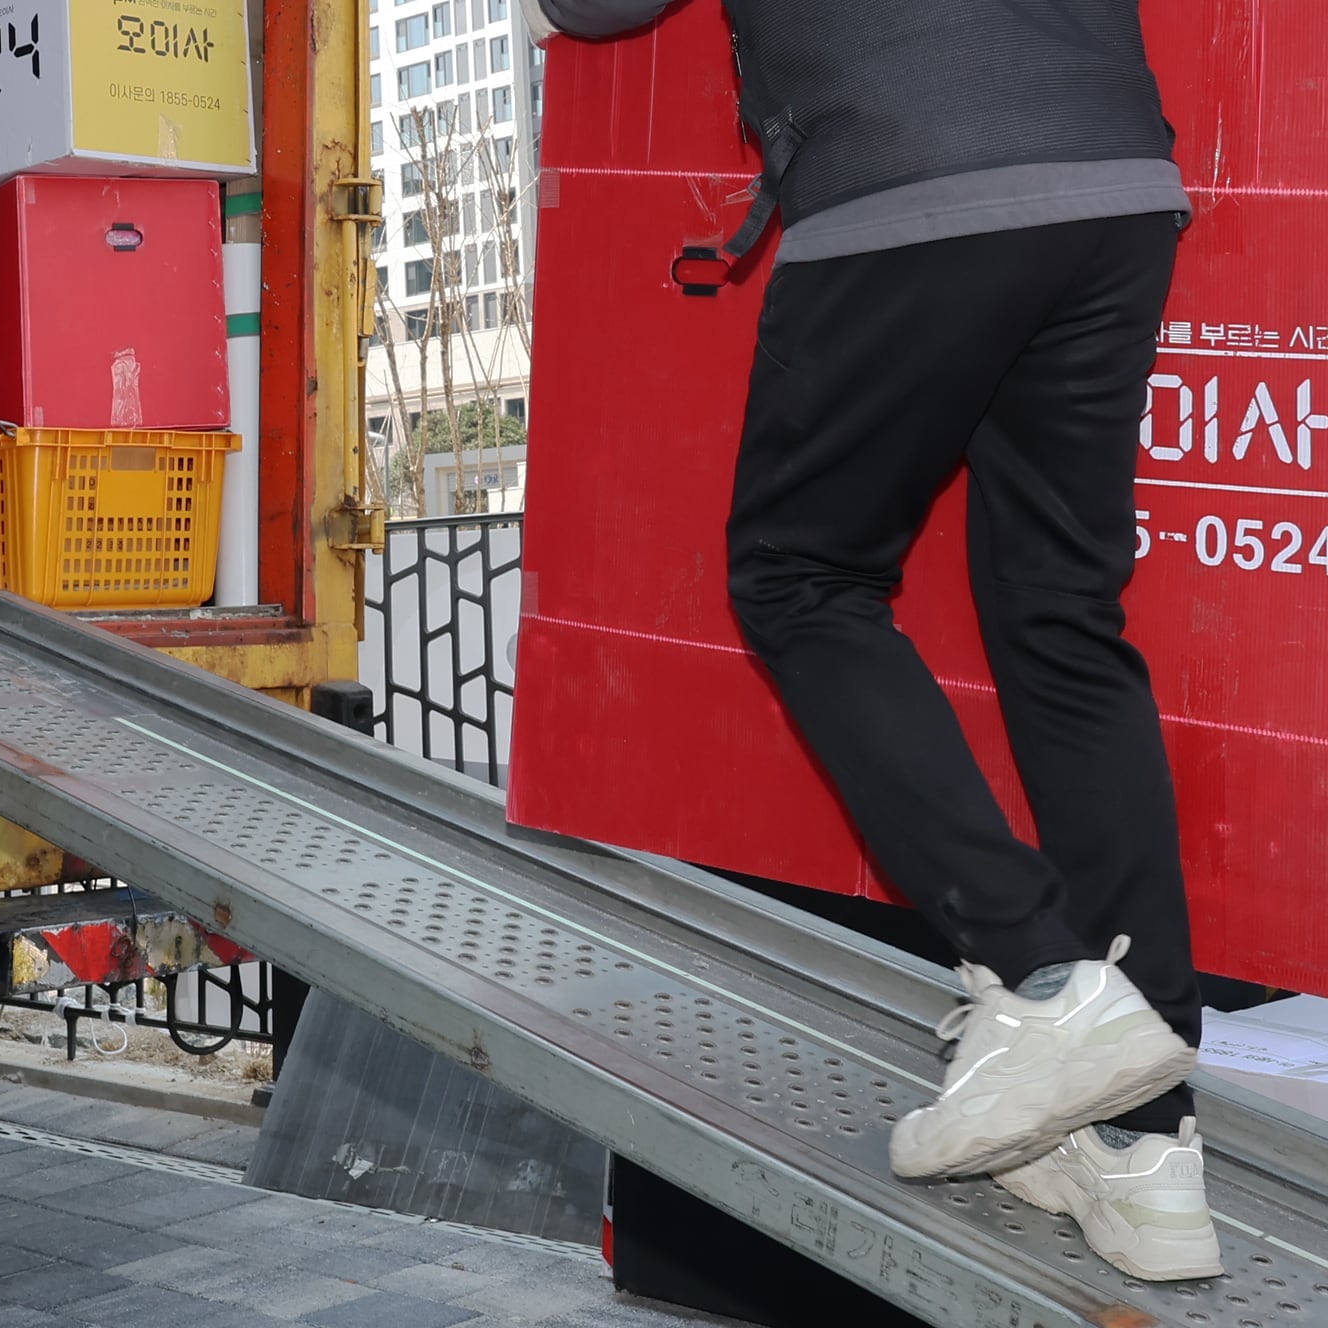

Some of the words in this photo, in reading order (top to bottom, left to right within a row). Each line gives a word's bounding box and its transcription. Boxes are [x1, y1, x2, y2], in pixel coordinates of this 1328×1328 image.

[117, 15, 214, 63] 오이사
[109, 83, 155, 103] 이사문의
[160, 90, 221, 111] 1855-0524
[1200, 322, 1280, 348] 부르는
